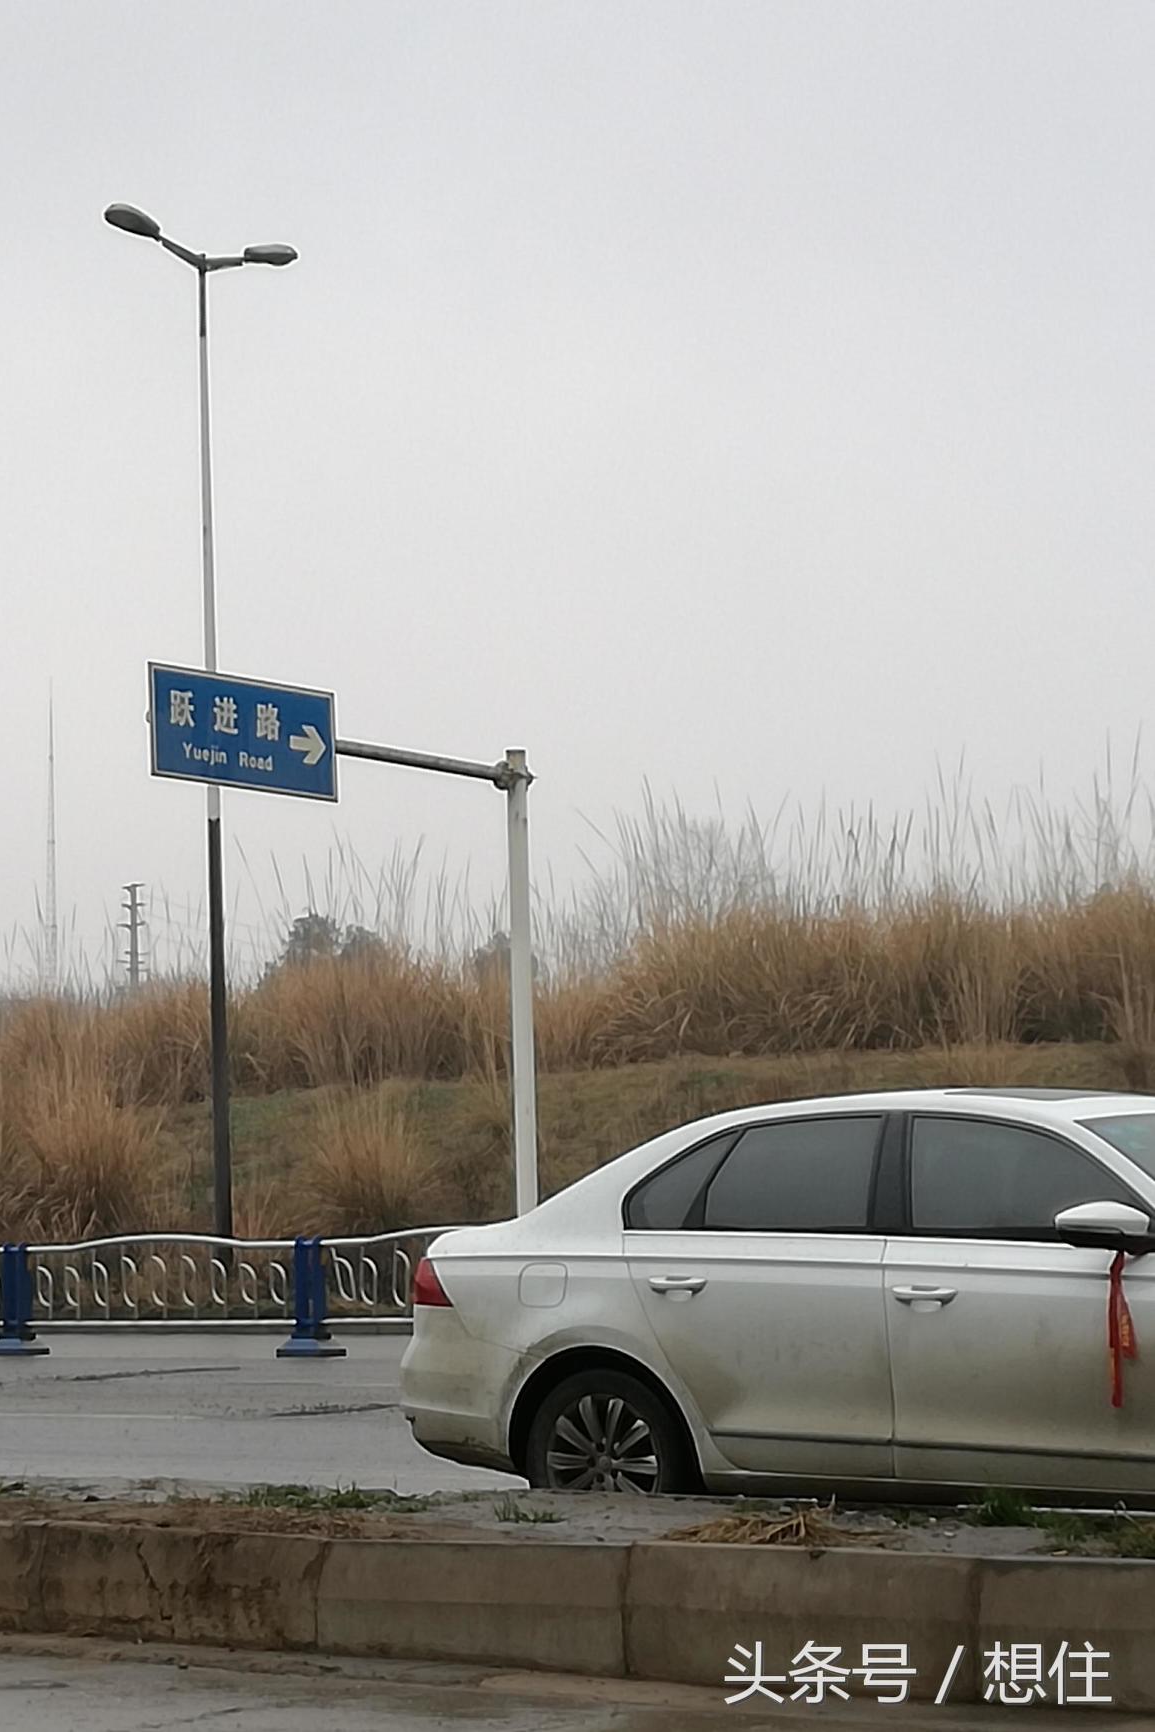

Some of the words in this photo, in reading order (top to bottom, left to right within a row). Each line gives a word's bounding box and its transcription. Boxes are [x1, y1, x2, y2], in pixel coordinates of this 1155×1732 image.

[169, 690, 280, 741] 跃进路
[182, 742, 227, 765] Yuejin
[239, 751, 273, 771] Road
